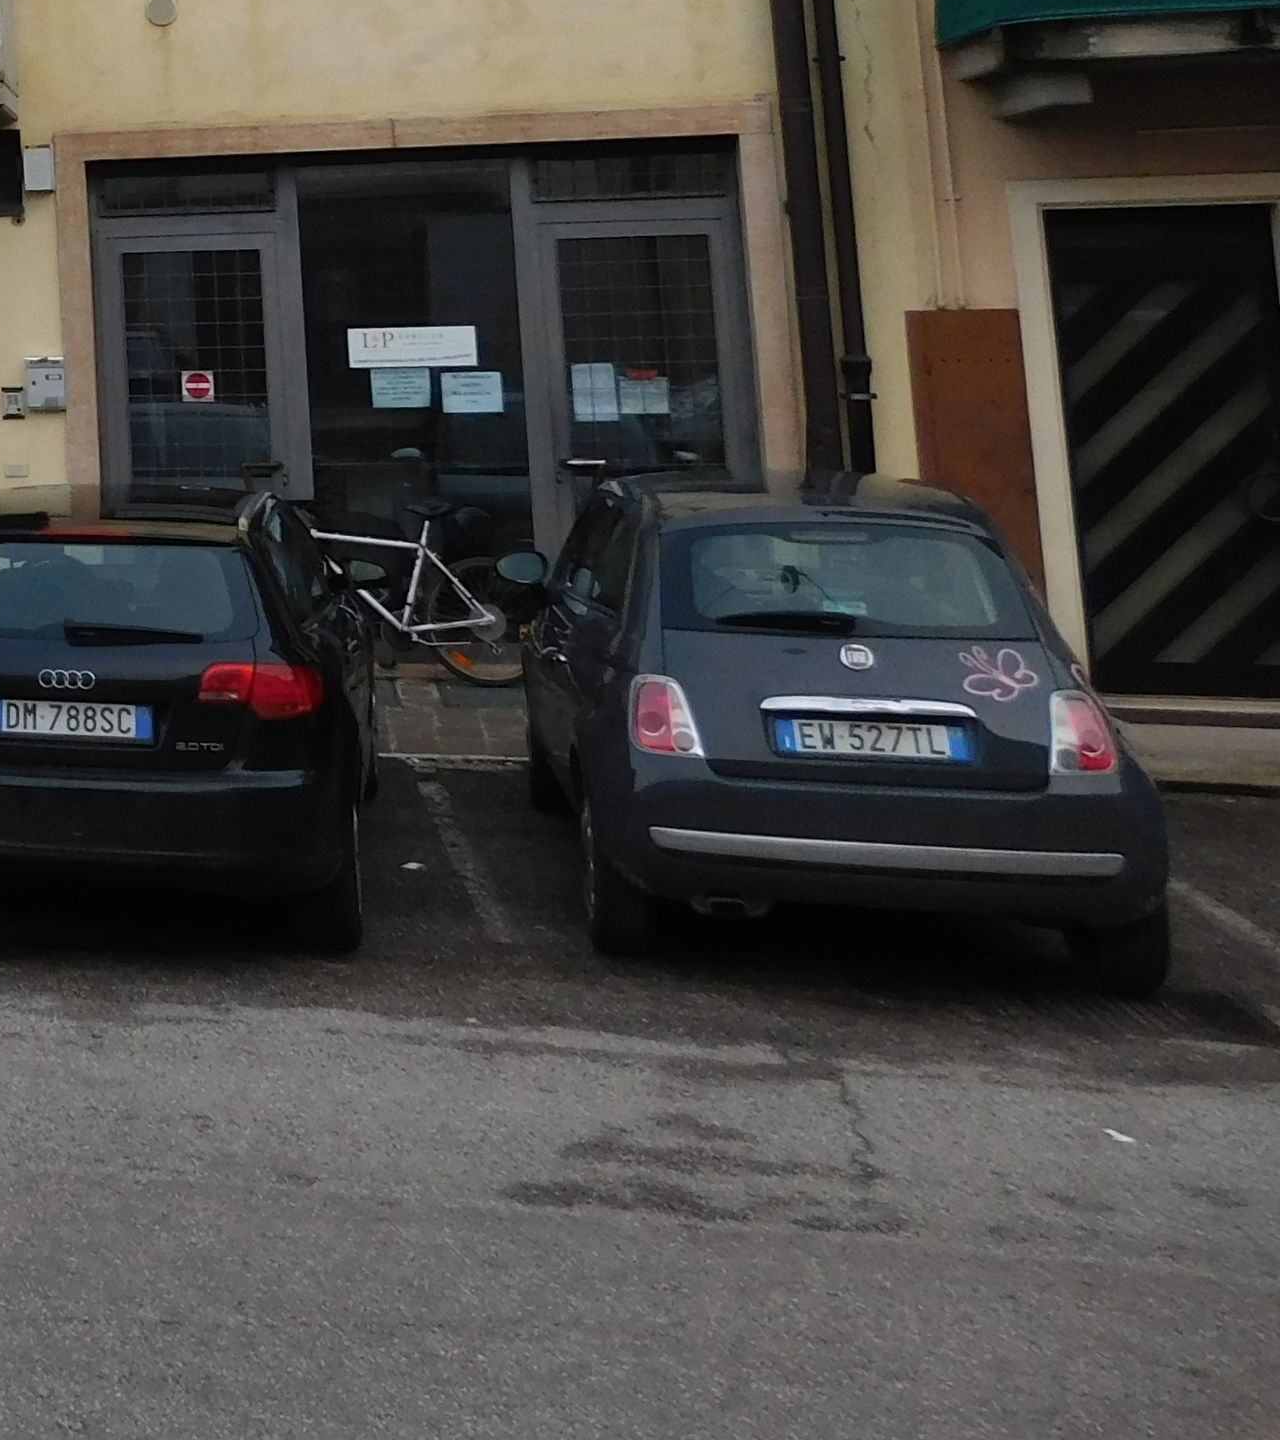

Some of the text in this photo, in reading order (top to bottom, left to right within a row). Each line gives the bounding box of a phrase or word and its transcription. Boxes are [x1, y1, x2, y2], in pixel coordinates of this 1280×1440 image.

[6, 703, 37, 730] DM
[49, 704, 132, 734] 788SC
[799, 723, 836, 750] EW
[848, 724, 946, 755] 527TL
